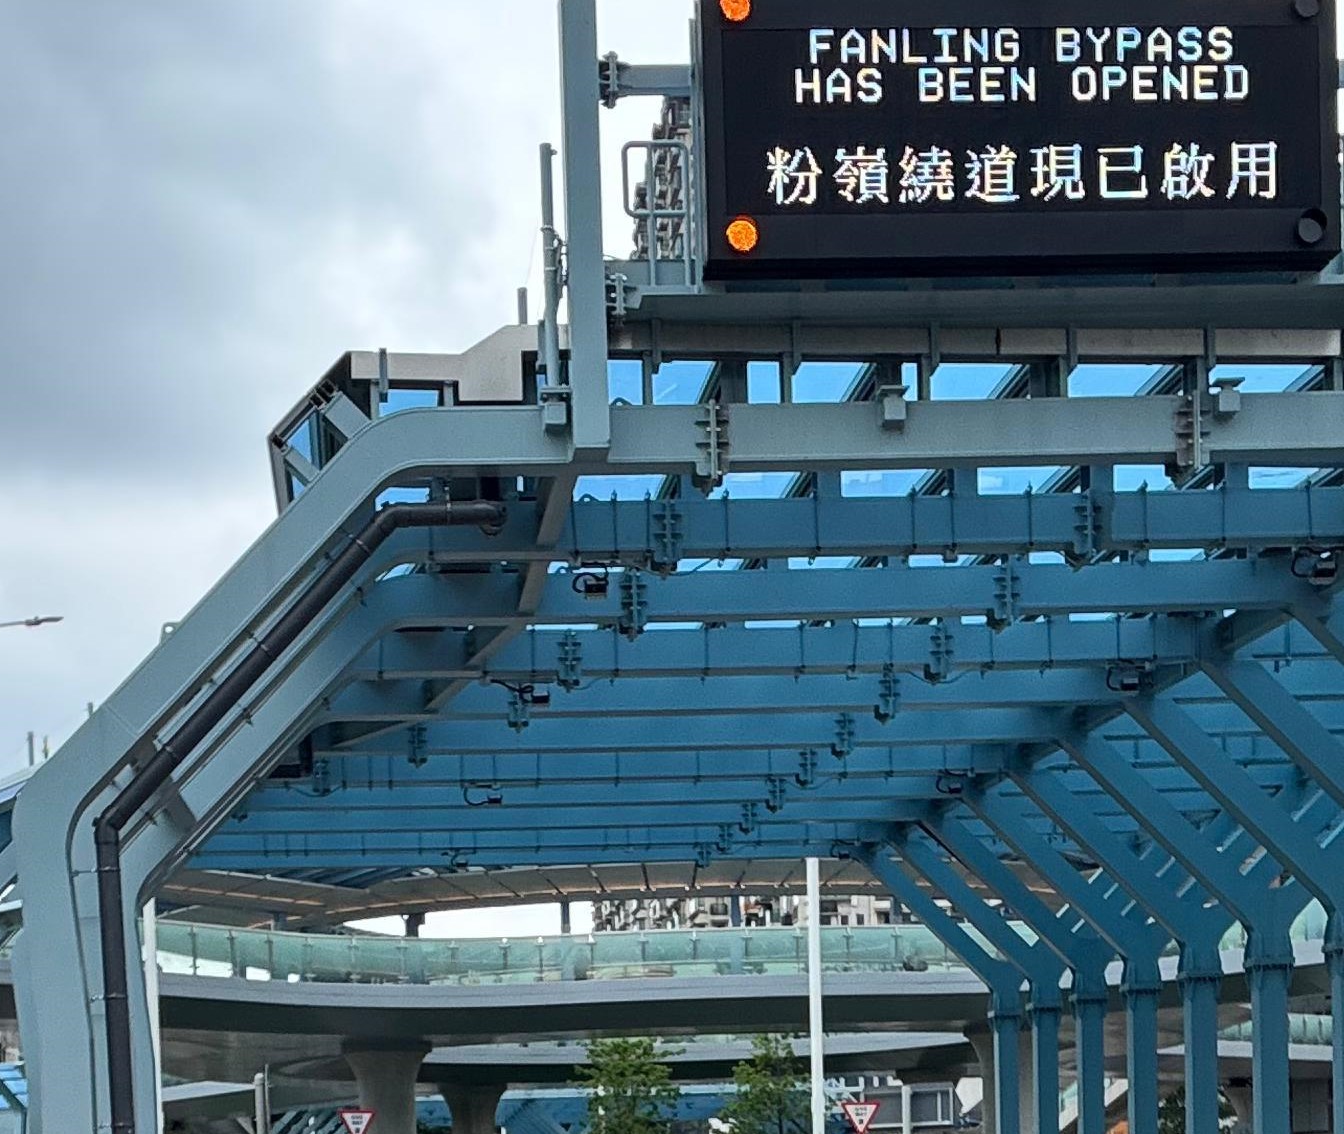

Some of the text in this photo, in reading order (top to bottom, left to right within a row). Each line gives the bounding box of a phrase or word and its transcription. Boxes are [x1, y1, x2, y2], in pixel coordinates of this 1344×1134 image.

[809, 26, 1233, 65] FANLING BYPASS
[794, 65, 1250, 103] HAS BEEN OPENED
[766, 140, 1278, 204] 粉嶺繞道現已啟用
